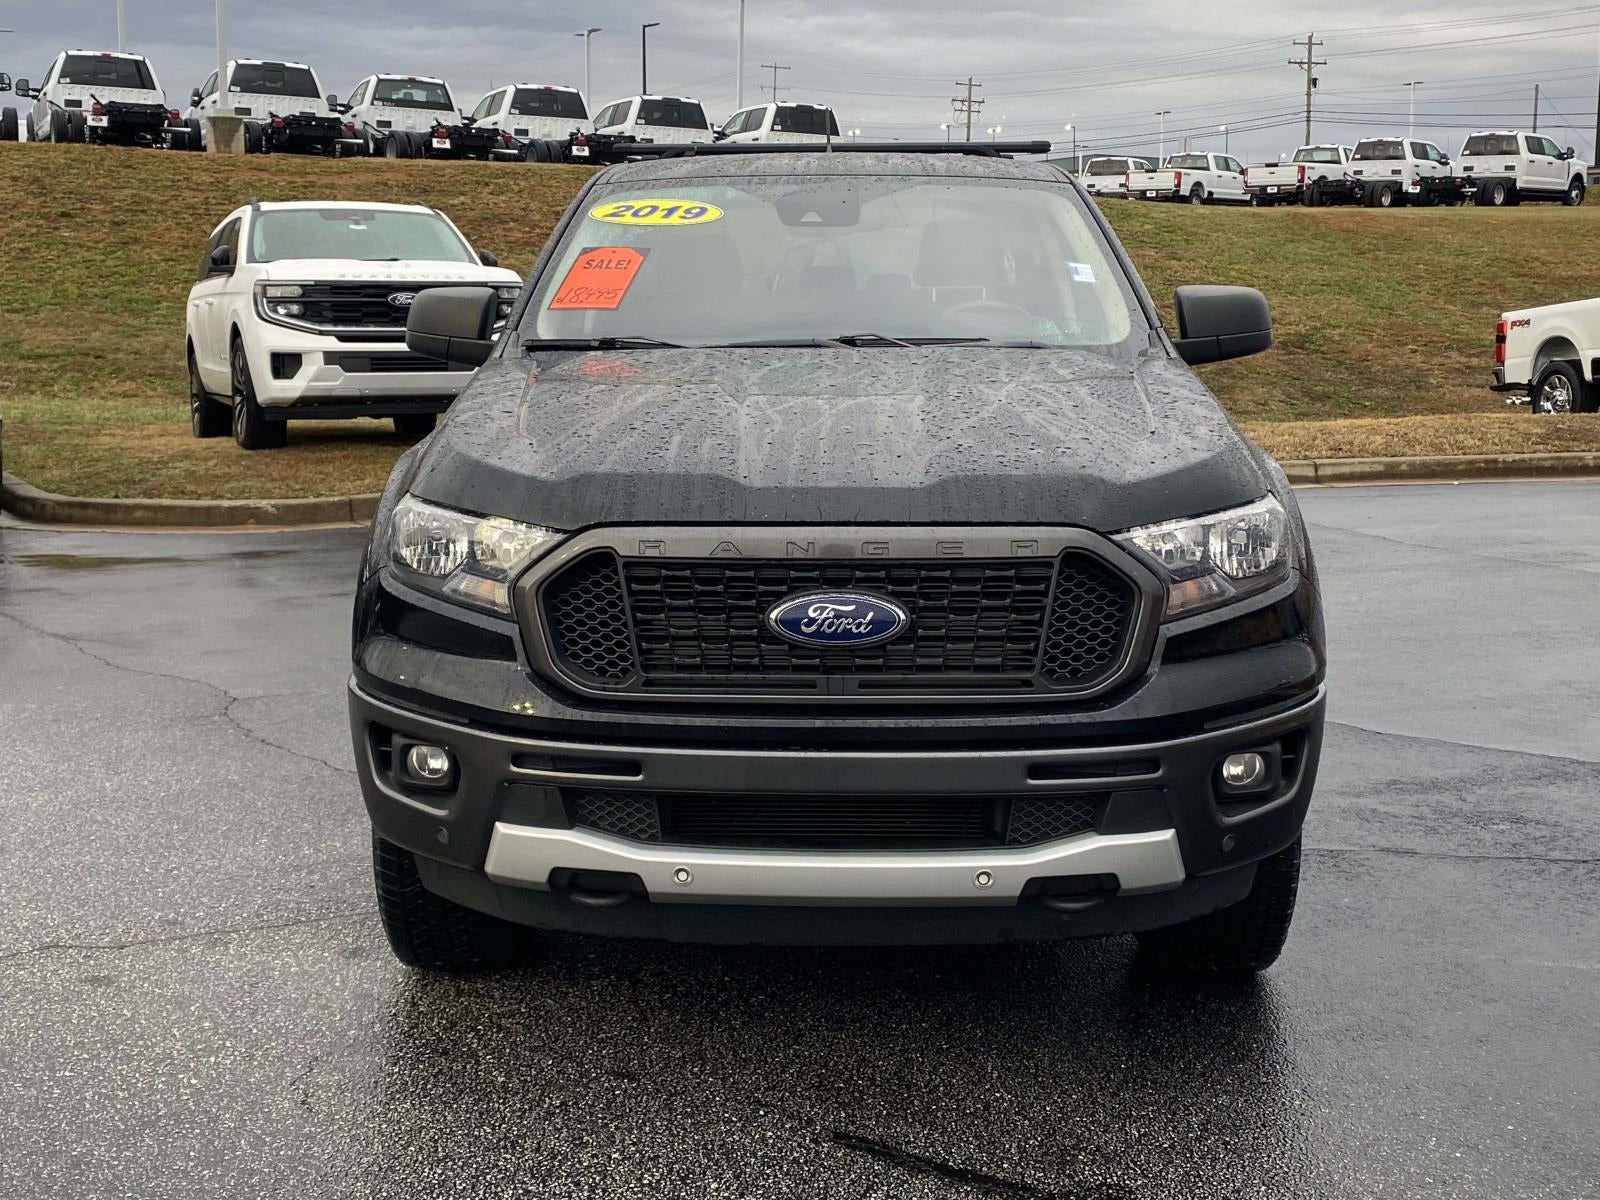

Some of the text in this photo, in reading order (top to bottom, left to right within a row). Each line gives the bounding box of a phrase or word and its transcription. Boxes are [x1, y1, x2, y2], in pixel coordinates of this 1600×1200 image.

[604, 204, 709, 220] 2019
[583, 258, 632, 270] SALE!
[638, 539, 1040, 557] RANGER
[799, 603, 875, 635] Ford
